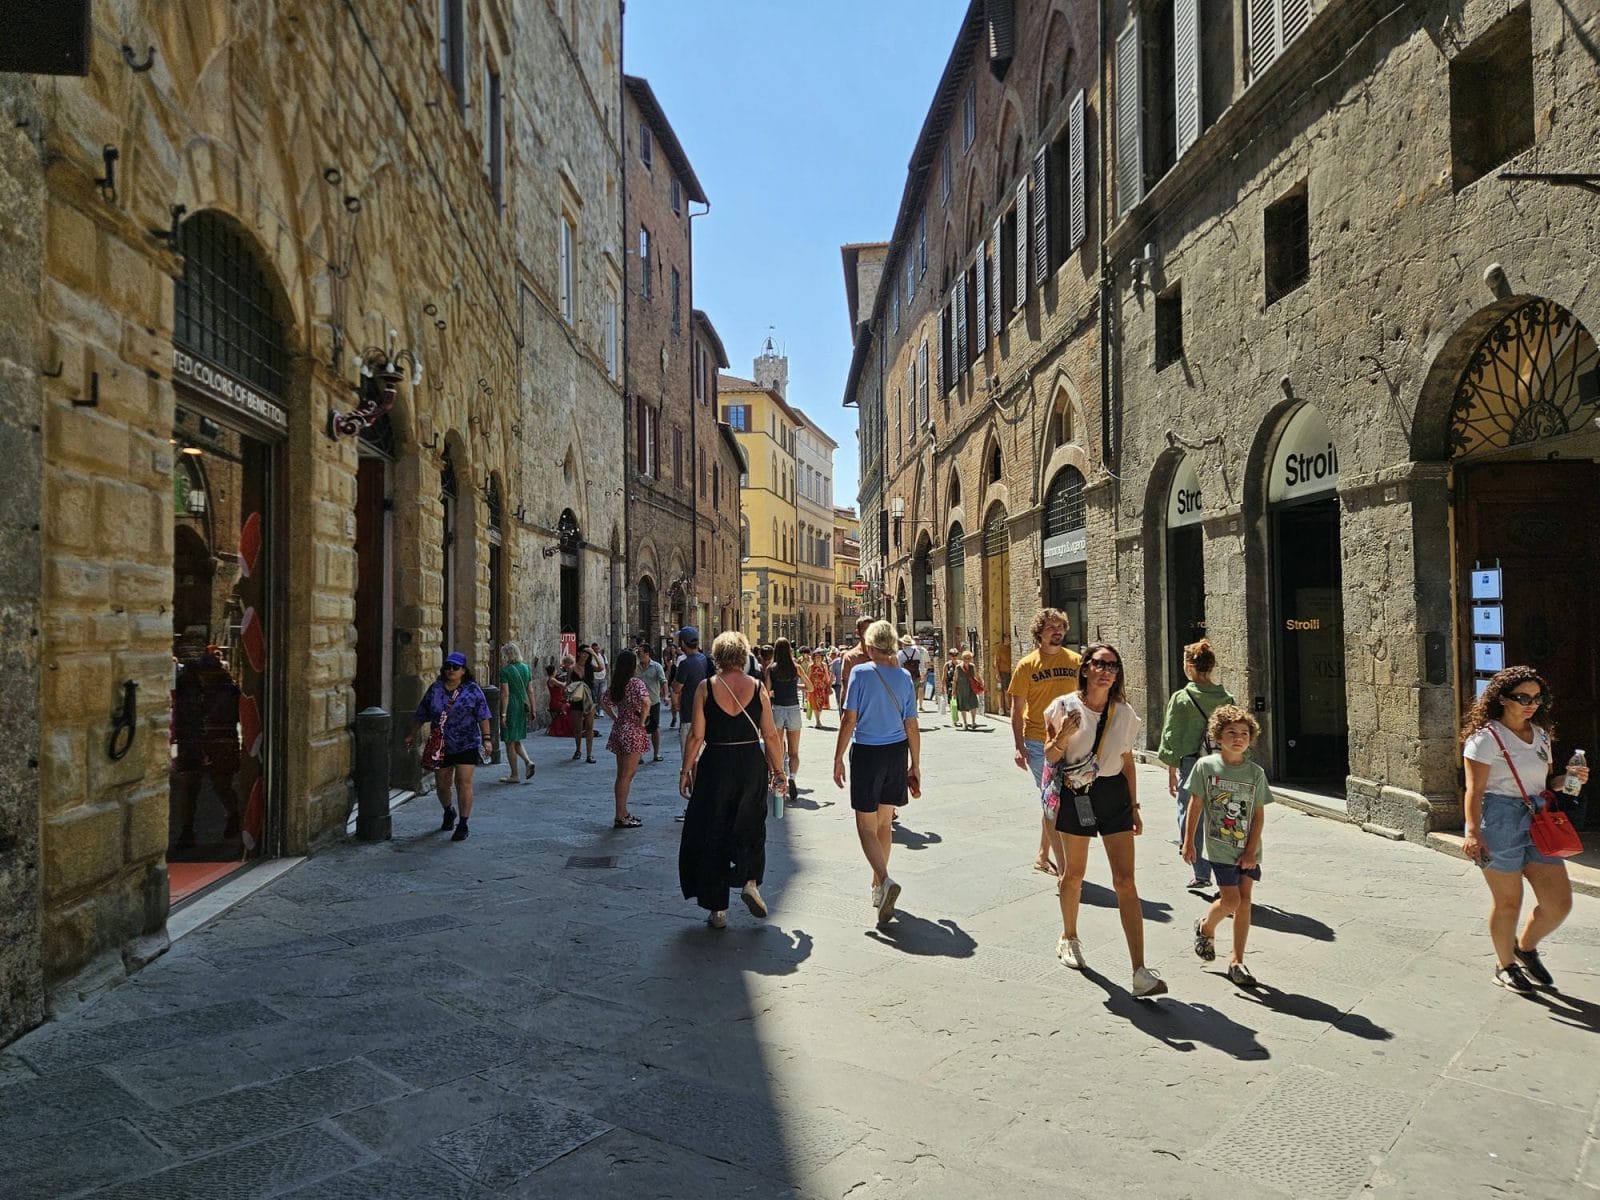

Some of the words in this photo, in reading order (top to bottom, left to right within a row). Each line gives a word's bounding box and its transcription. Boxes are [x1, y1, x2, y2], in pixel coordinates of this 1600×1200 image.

[194, 362, 233, 398] COLORS
[234, 384, 247, 405] OF
[1031, 668, 1052, 682] SAN
